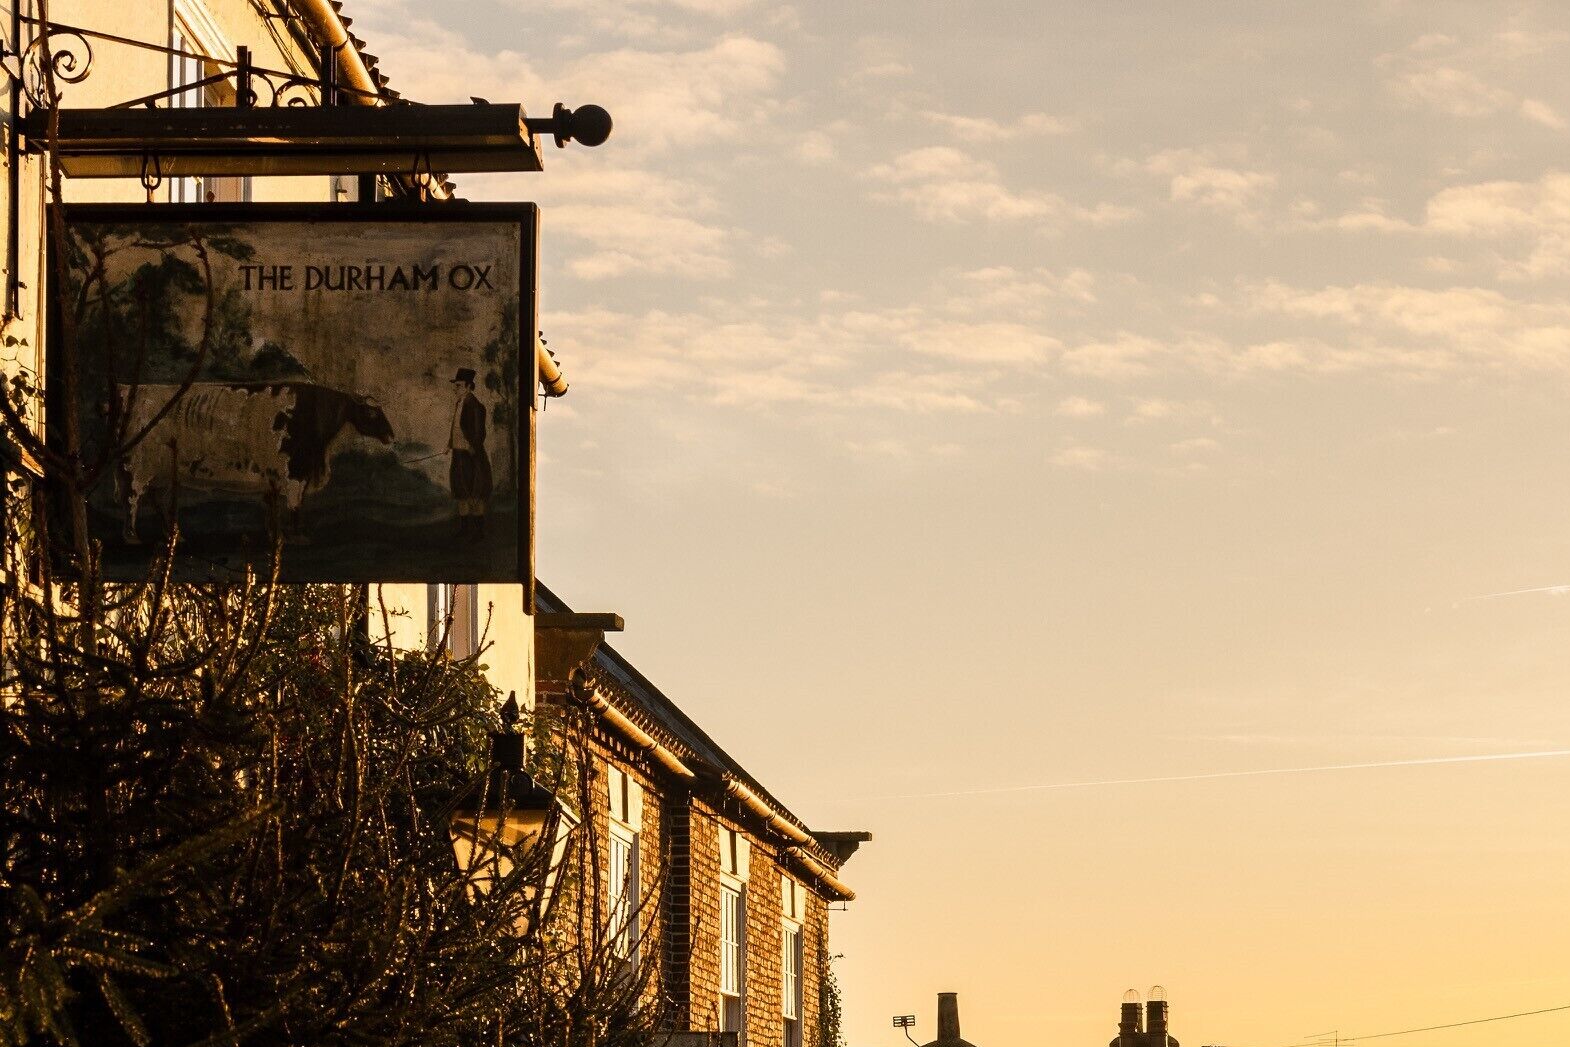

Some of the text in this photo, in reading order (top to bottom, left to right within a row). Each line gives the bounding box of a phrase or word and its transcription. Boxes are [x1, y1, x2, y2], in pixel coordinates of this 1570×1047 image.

[238, 264, 494, 291] THE DURHAM OX
